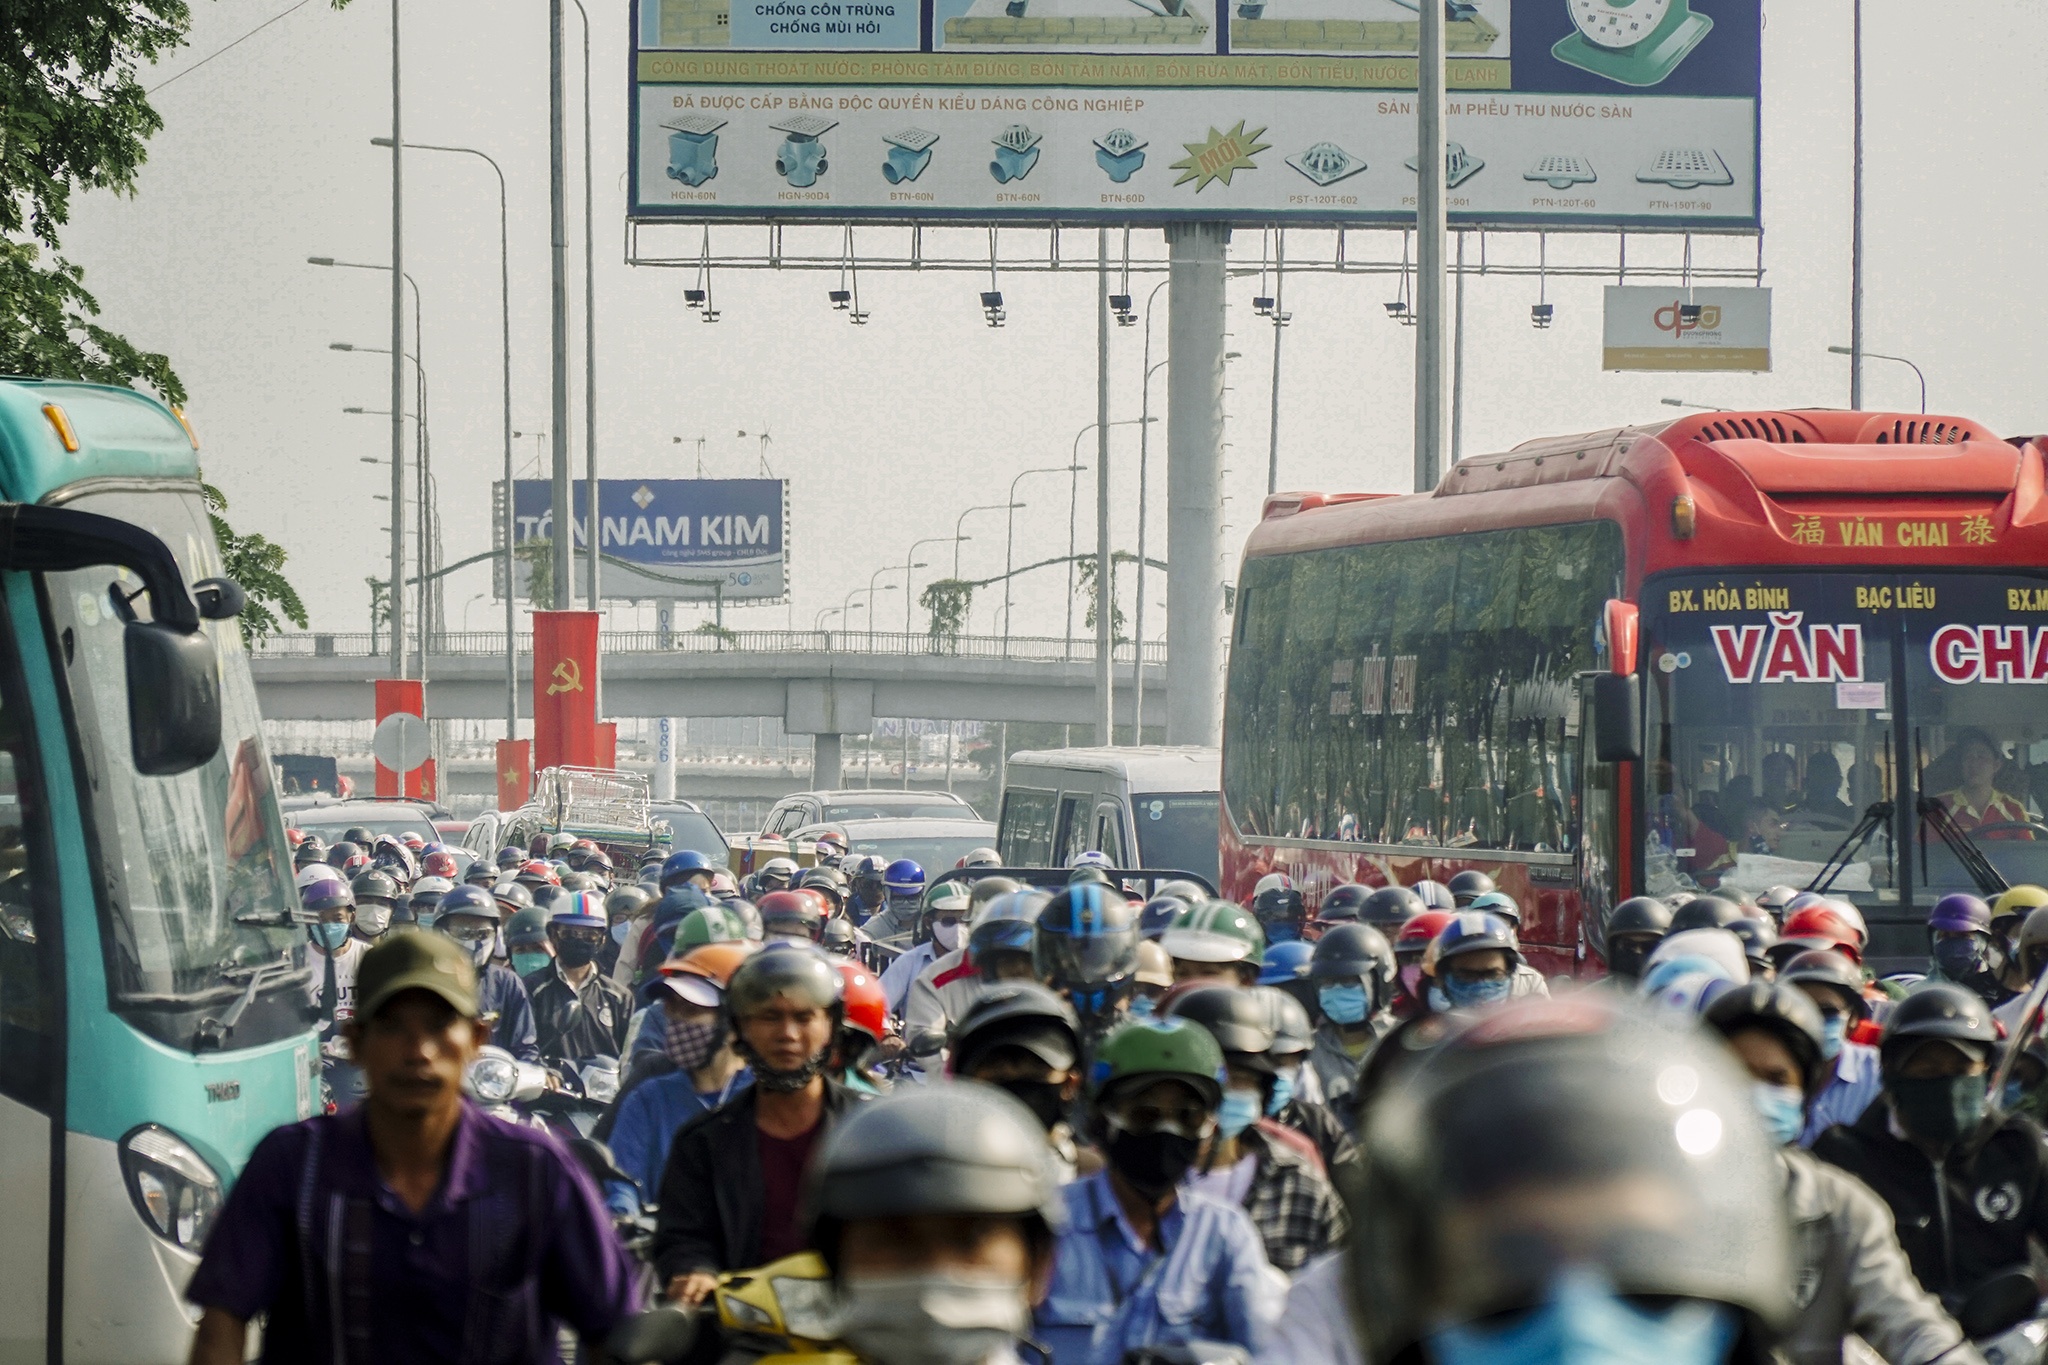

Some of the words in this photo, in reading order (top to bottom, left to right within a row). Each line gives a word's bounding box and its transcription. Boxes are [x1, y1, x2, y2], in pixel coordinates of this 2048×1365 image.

[755, 1, 806, 16] CHỐNG
[811, 1, 844, 16] CÔN
[846, 1, 896, 17] TRÙNG
[770, 19, 821, 34] CHỐNG
[826, 20, 852, 34] MÙI
[856, 20, 881, 34] HÔI
[651, 57, 698, 75] CÔNG
[704, 61, 750, 79] DỤNG
[756, 58, 810, 76] THOÁT
[814, 58, 866, 77] NƯỚC:
[871, 58, 928, 77] PHÒNG
[973, 59, 1025, 79] ĐỨNG,
[1030, 57, 1064, 77] BỒN
[1156, 58, 1191, 79] BỒN
[1196, 60, 1229, 79] RỬA
[1278, 60, 1312, 80] BỒN
[1363, 62, 1409, 81] NƯỚC
[673, 93, 694, 109] ĐÃ
[700, 95, 745, 112] ĐƯỢC
[750, 92, 783, 110] CẤP
[788, 92, 834, 110] BẰNG
[838, 94, 873, 112] ĐỘC
[878, 92, 933, 110] QUYỀN
[938, 92, 976, 111] KIỂU
[981, 95, 1027, 111] DÁNG
[1031, 95, 1078, 112] CÔNG
[1083, 95, 1145, 115] NGHIỆP
[1378, 98, 1410, 115] SẢN
[1514, 103, 1546, 117] THU
[1550, 102, 1596, 118] NƯỚC
[1601, 102, 1633, 119] SÀN
[1199, 137, 1243, 175] MỚI
[671, 191, 717, 200] HGN-60N
[777, 191, 830, 200] HGN-90D4
[890, 192, 934, 201] BTN-60N
[996, 192, 1041, 202] BTN-60N
[1100, 193, 1145, 203] BTN-60D
[1289, 195, 1358, 205] PST-120T-602
[1532, 198, 1596, 208] PTN-120T-60
[1649, 200, 1712, 210] PTN-150T-90
[602, 516, 690, 546] NAM
[701, 514, 769, 546] KIM
[1790, 514, 1825, 545] 福
[1839, 516, 1883, 547] VĂN
[1897, 521, 1949, 547] CHAI
[1669, 590, 1699, 613] BX.
[1703, 582, 1741, 611] HÒA
[1745, 581, 1789, 610] BÌNH
[1856, 587, 1892, 614] BẠC
[1896, 582, 1936, 609] LIÊU
[1709, 610, 1864, 683] VĂN
